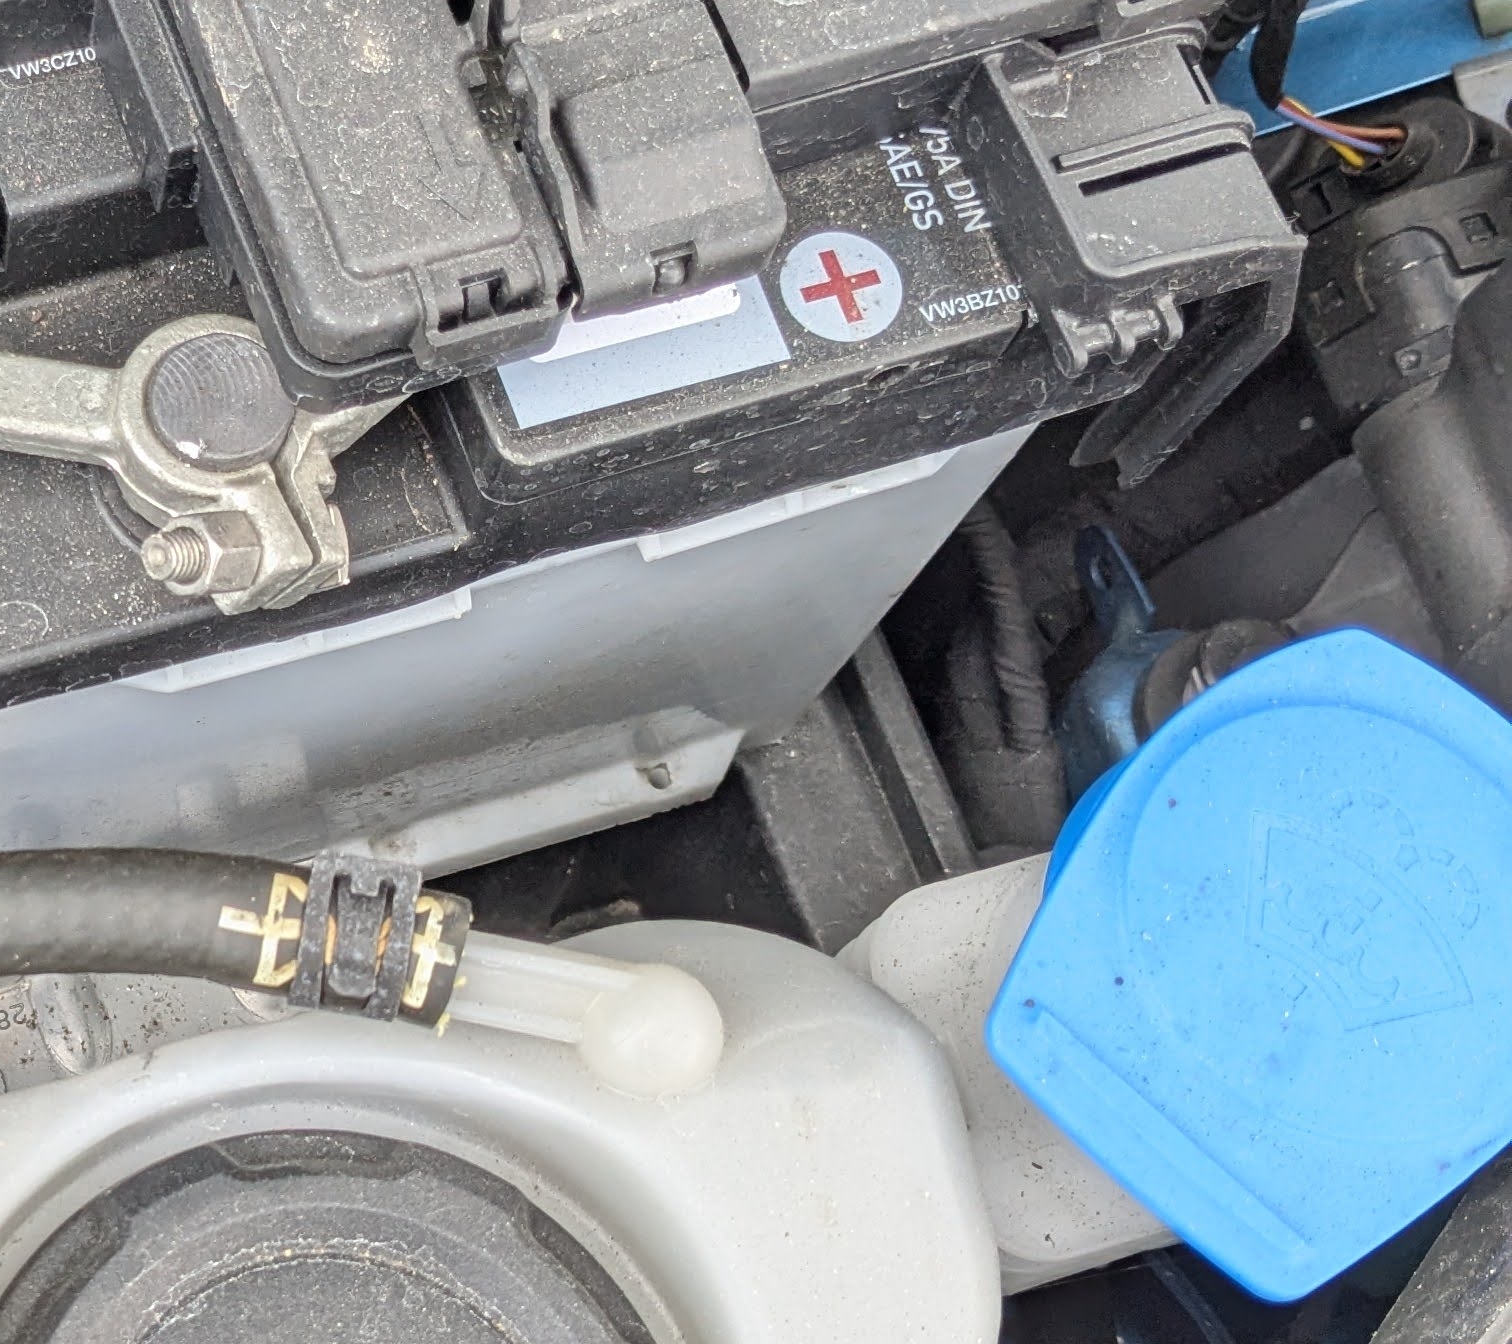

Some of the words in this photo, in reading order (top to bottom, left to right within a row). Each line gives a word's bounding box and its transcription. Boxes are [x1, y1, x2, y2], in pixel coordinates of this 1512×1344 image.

[877, 132, 944, 233] AE/GS
[944, 176, 992, 233] DIN
[918, 281, 1022, 323] VW3BZ10
